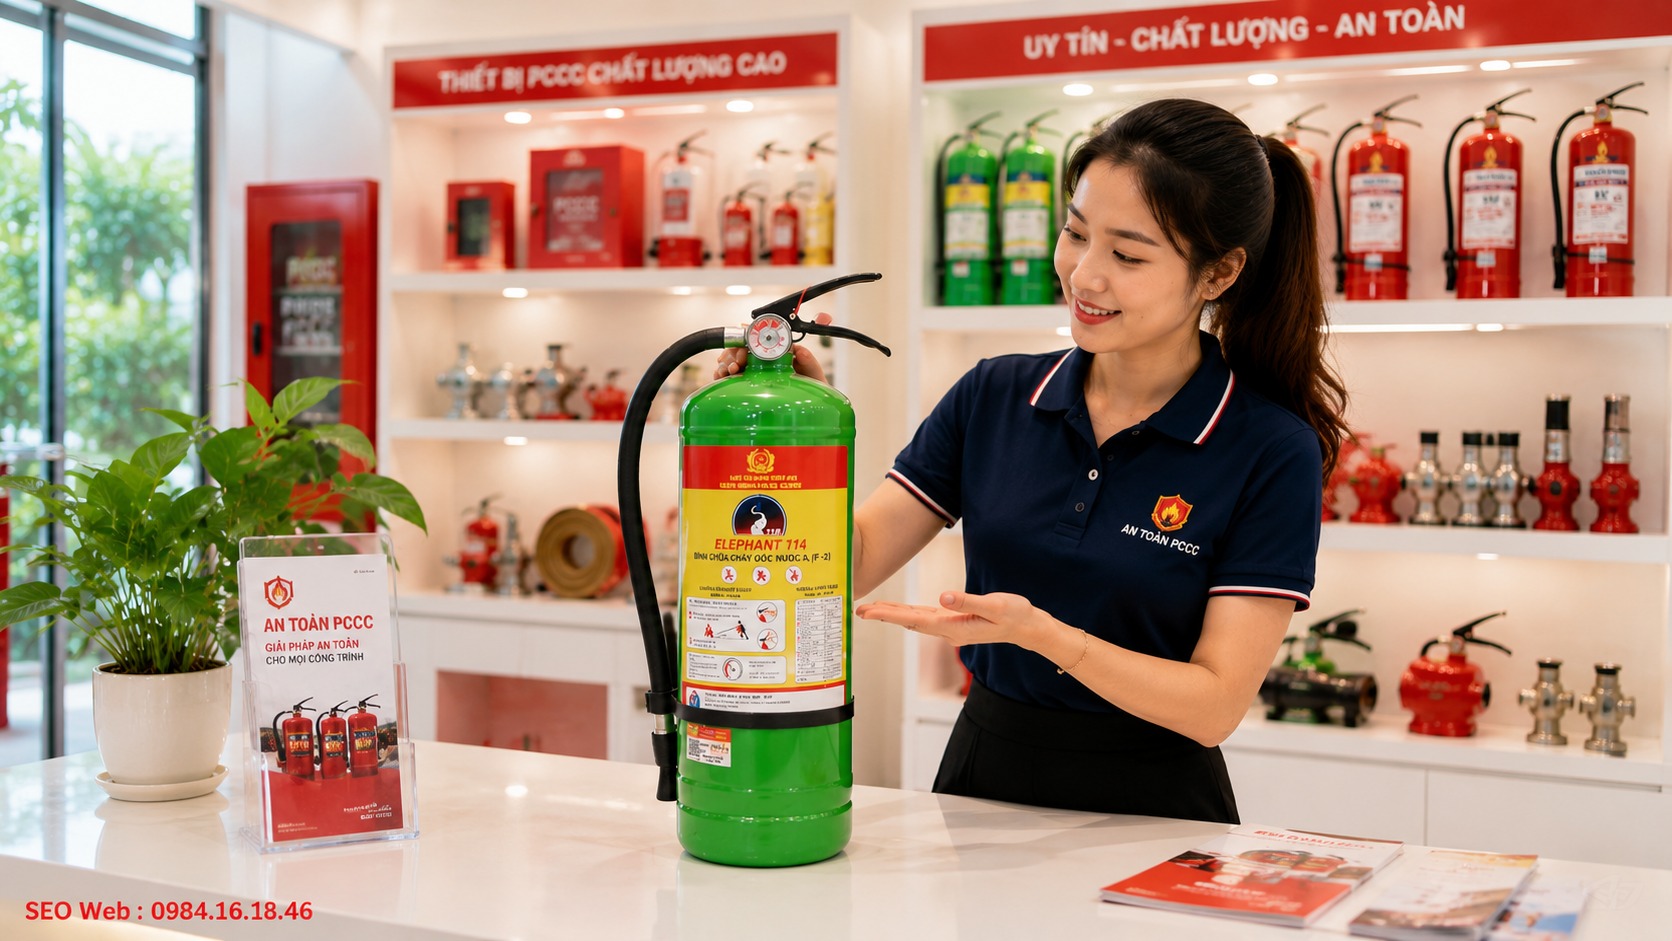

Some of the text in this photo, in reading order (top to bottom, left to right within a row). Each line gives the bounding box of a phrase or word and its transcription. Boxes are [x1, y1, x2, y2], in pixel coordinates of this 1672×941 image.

[1023, 0, 1466, 60] UY TÍN - CHẤT LƯỢNG - AN TOÀN
[437, 50, 788, 95] THIẾT BỊ PCCC CHẤT LƯỢNG CAO
[714, 538, 783, 551] ELEPHANT
[1120, 523, 1200, 556] AN TOÀN PCCC
[264, 612, 374, 633] AN TOÀN PCCC
[317, 640, 331, 650] AN
[265, 655, 286, 665] CHO
[288, 654, 306, 666] MỌI
[308, 652, 335, 664] CÔNG
